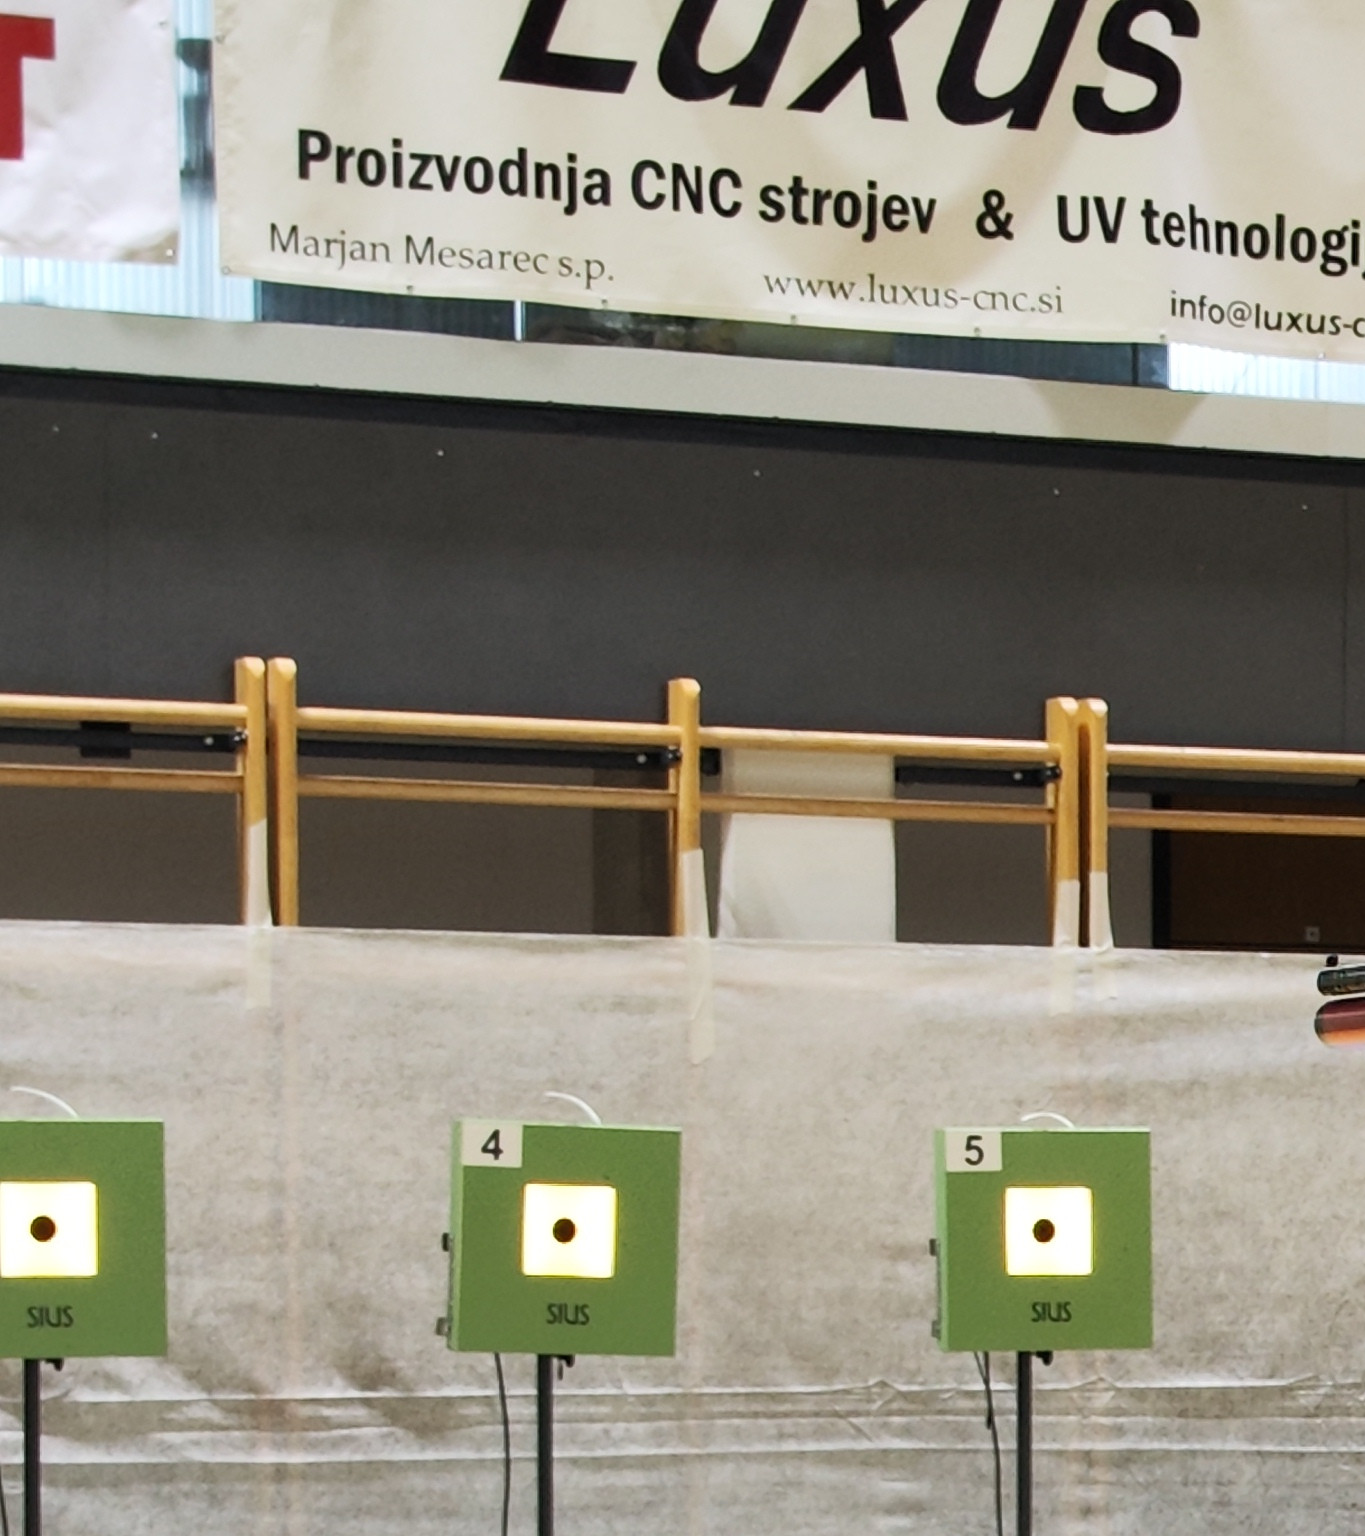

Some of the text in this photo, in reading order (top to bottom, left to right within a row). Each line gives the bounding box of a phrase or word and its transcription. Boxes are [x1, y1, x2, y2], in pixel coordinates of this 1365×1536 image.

[298, 128, 612, 216] Proizvodnja
[630, 159, 743, 219] CNC
[757, 175, 937, 243] strojev
[974, 189, 1014, 241] &
[1056, 195, 1128, 244] UV
[269, 223, 391, 268] Marjan
[404, 236, 549, 275] Mesarec
[557, 254, 615, 288] s.p.
[762, 272, 1063, 316] www.luxus-cnc.si
[480, 1129, 503, 1160] 4
[964, 1135, 984, 1166] 5
[27, 1305, 74, 1328] SIUS
[546, 1302, 590, 1325] SIUS
[1031, 1301, 1071, 1323] SIUS
